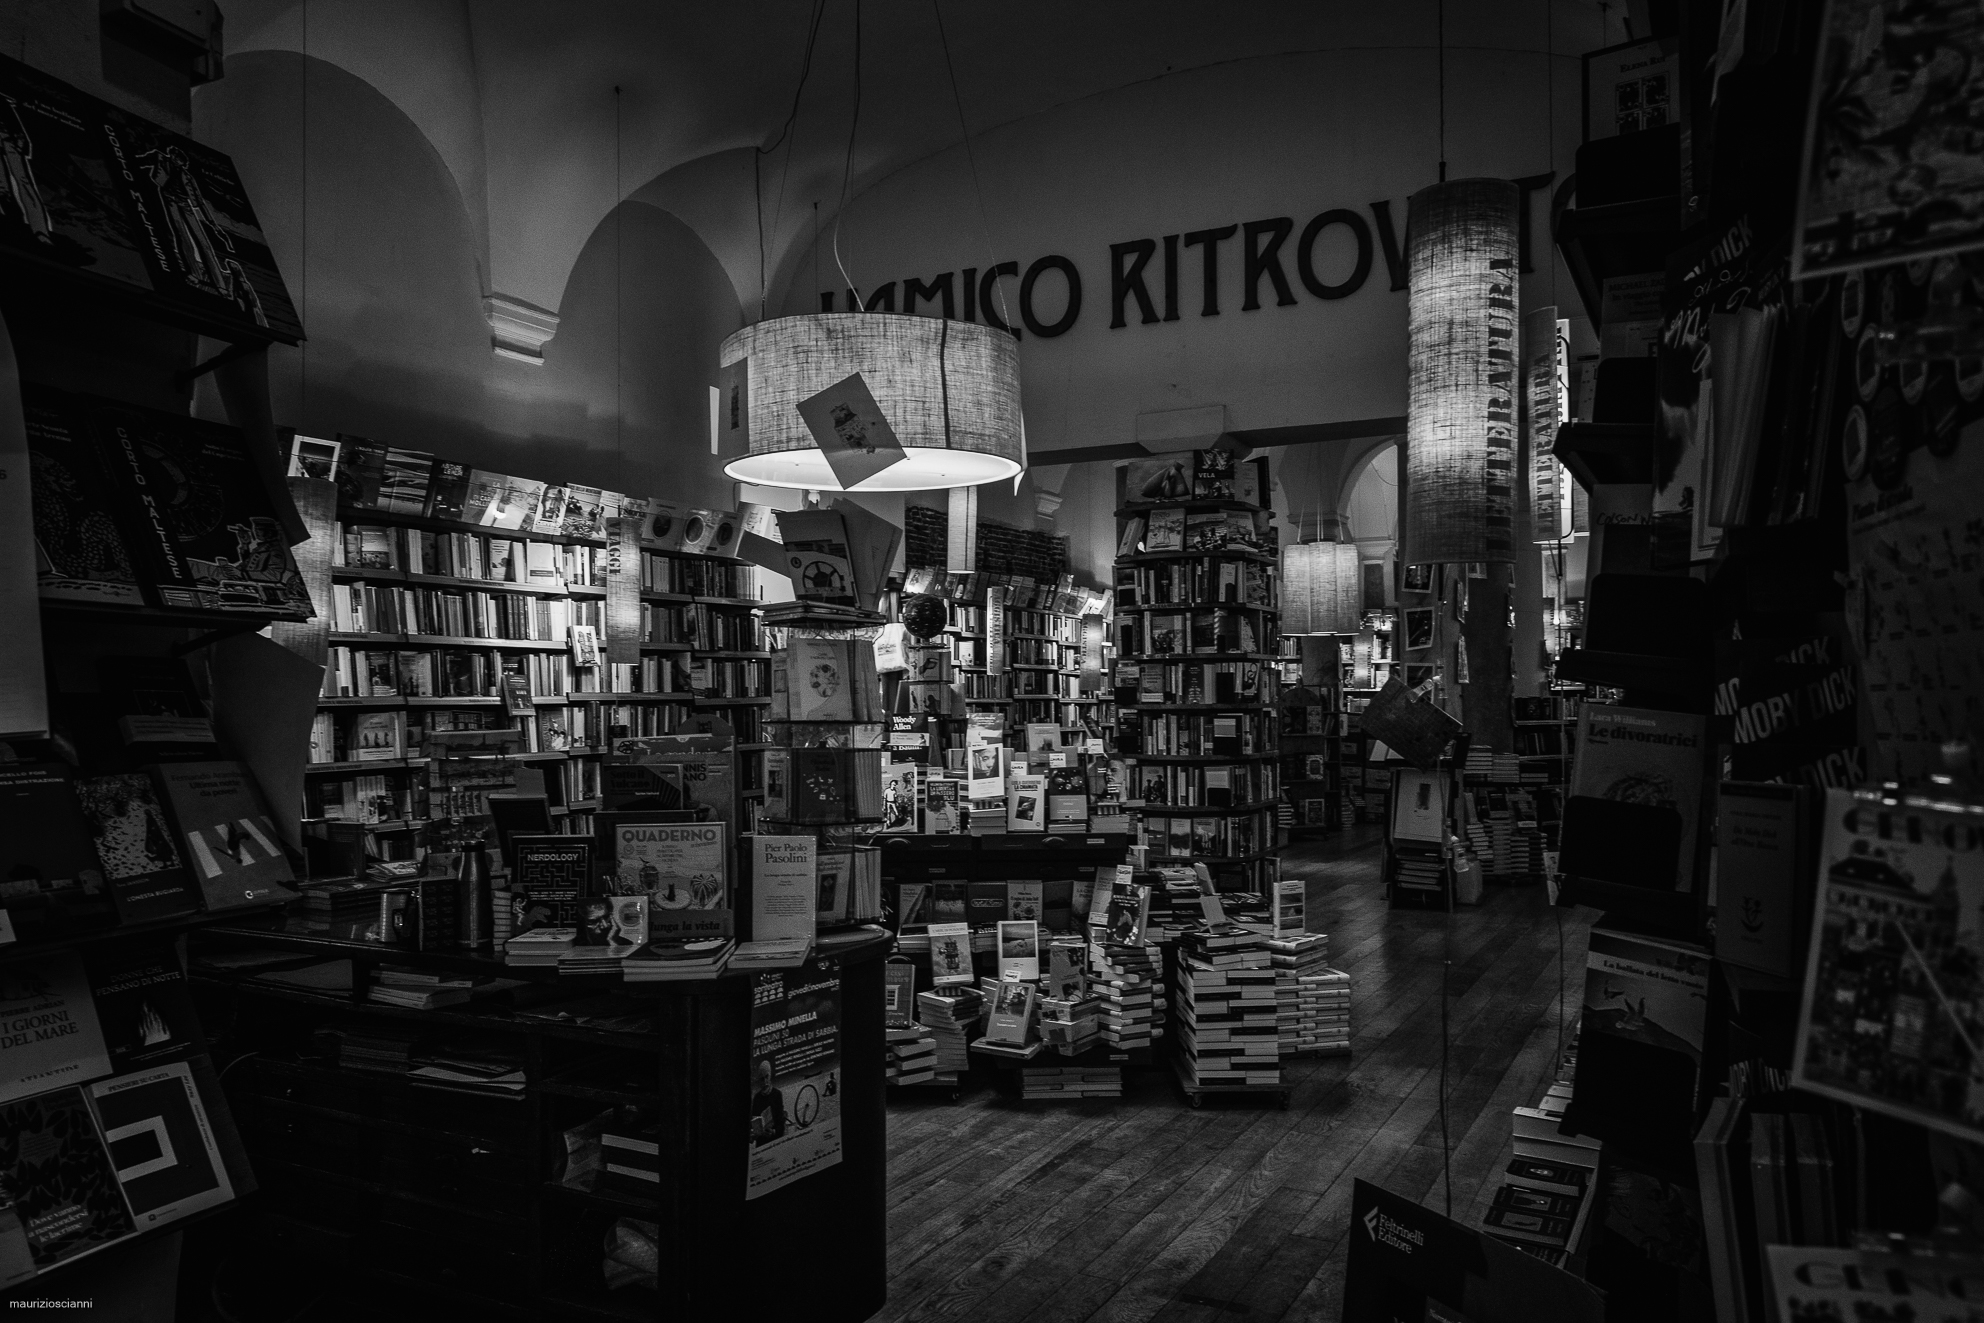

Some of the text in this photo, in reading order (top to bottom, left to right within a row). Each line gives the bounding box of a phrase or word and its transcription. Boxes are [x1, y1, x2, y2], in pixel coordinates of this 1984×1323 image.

[104, 124, 171, 273] CORTO MALTESE
[1110, 171, 1576, 330] RITROVT
[1486, 258, 1514, 551] LETTERATURA
[1533, 353, 1556, 535] LETTERATURA
[116, 427, 182, 579] CORTO MALTESE
[609, 521, 622, 574] VIAGGI
[1734, 689, 1800, 744] MOBY
[1807, 665, 1856, 721] DICK
[893, 716, 916, 724] Woody
[1613, 714, 1656, 727] Williams
[1589, 723, 1698, 749] Le divoratrici
[171, 773, 211, 781] Fernando
[189, 781, 218, 789] Ultima
[610, 770, 635, 779] Sotto
[200, 788, 238, 797] da poveri
[622, 829, 717, 843] QUADERNO
[764, 843, 807, 852] Pier Paolo
[765, 853, 807, 863] Pasolini
[649, 921, 720, 933] lunga la vista
[110, 965, 164, 983] DONNE CHE
[1604, 960, 1614, 968] La
[1616, 962, 1644, 976] ballata
[1645, 968, 1660, 978] del
[96, 971, 182, 997] PENSANO DI NOTTE
[1, 1000, 65, 1018] PIERRE ADRIAN
[3, 1010, 70, 1034] I GIORNI
[754, 1011, 817, 1037] MASSIMO MINELLA
[1, 1022, 79, 1050] DEL MARE
[753, 1032, 780, 1047] PASOLINI
[753, 1048, 761, 1057] LA
[761, 1041, 782, 1054] LUNGA
[783, 1034, 807, 1047] STRADA
[808, 1031, 815, 1039] DI
[108, 1079, 139, 1092] PENSIERI
[150, 1072, 170, 1083] CARTA
[1378, 1227, 1413, 1254] Editore
[1379, 1213, 1424, 1246] Feltrinelli
